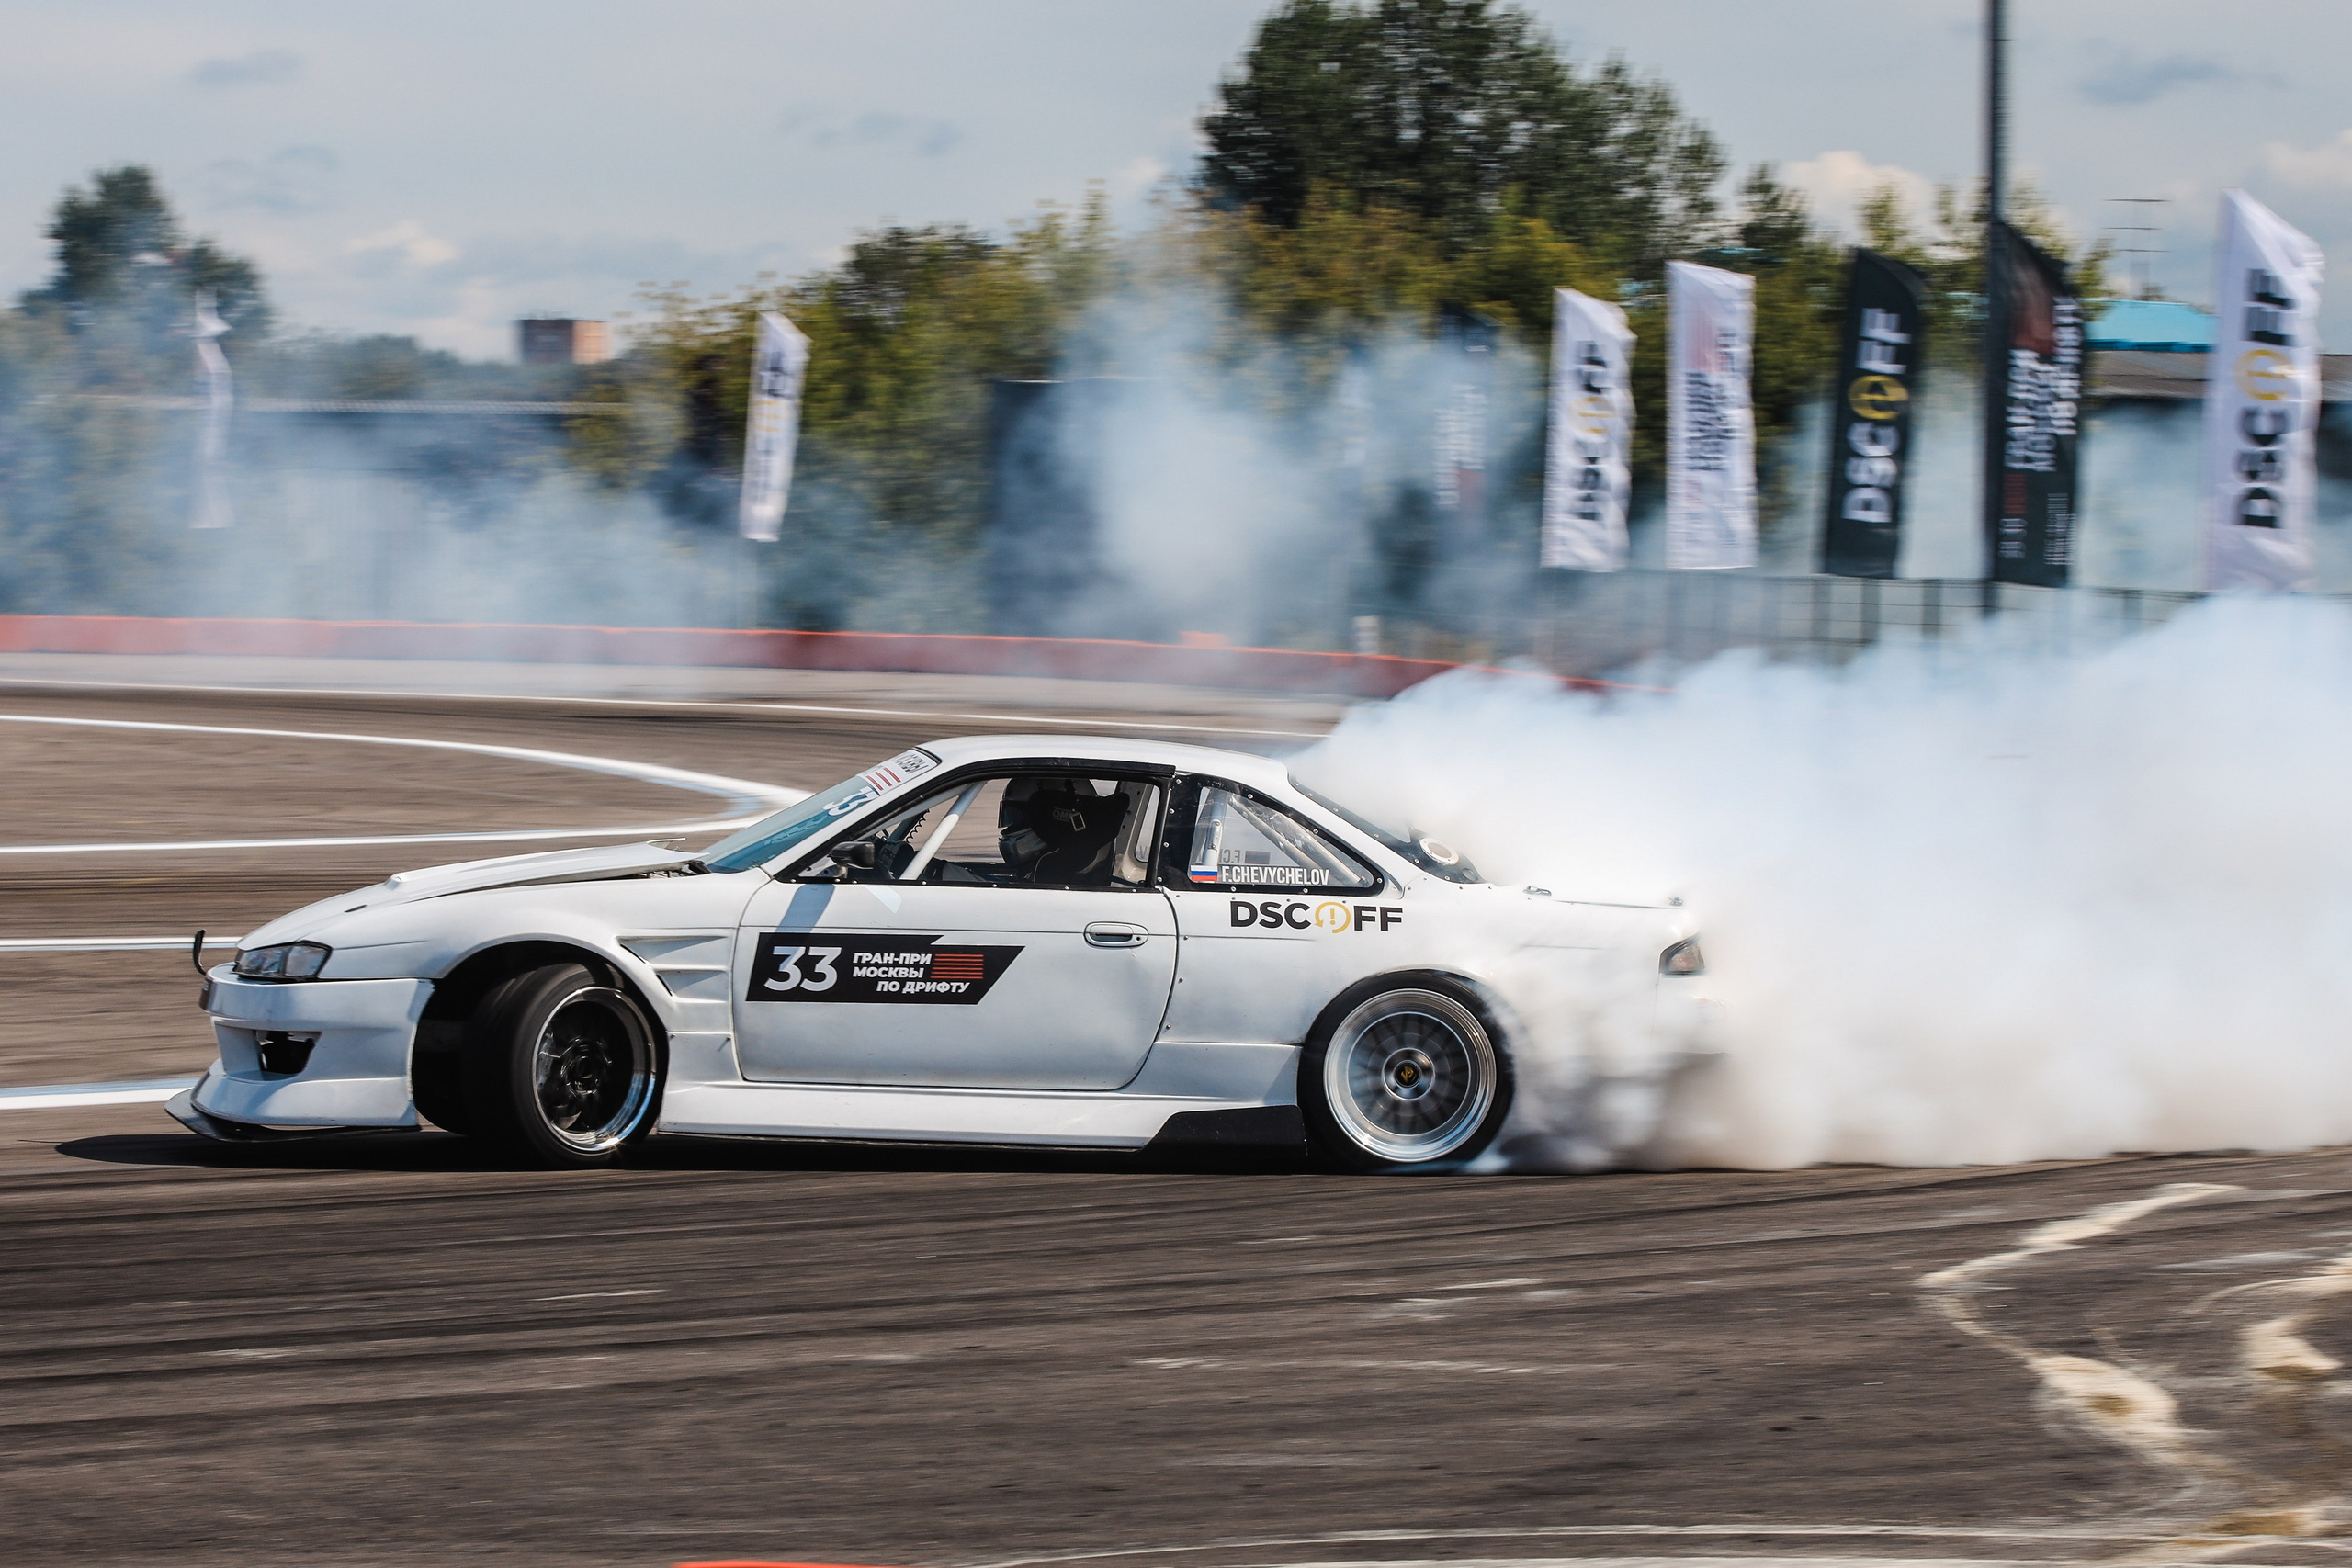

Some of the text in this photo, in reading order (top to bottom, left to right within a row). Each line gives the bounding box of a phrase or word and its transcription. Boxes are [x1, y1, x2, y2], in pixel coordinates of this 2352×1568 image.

[1222, 866, 1329, 886] F.CHEVYCHELOV
[853, 953, 932, 964] ГРАН-ПРИ
[764, 946, 842, 992] 33
[853, 966, 924, 978] МОСКВЫ
[876, 982, 970, 994] ПО ДРИФТУ
